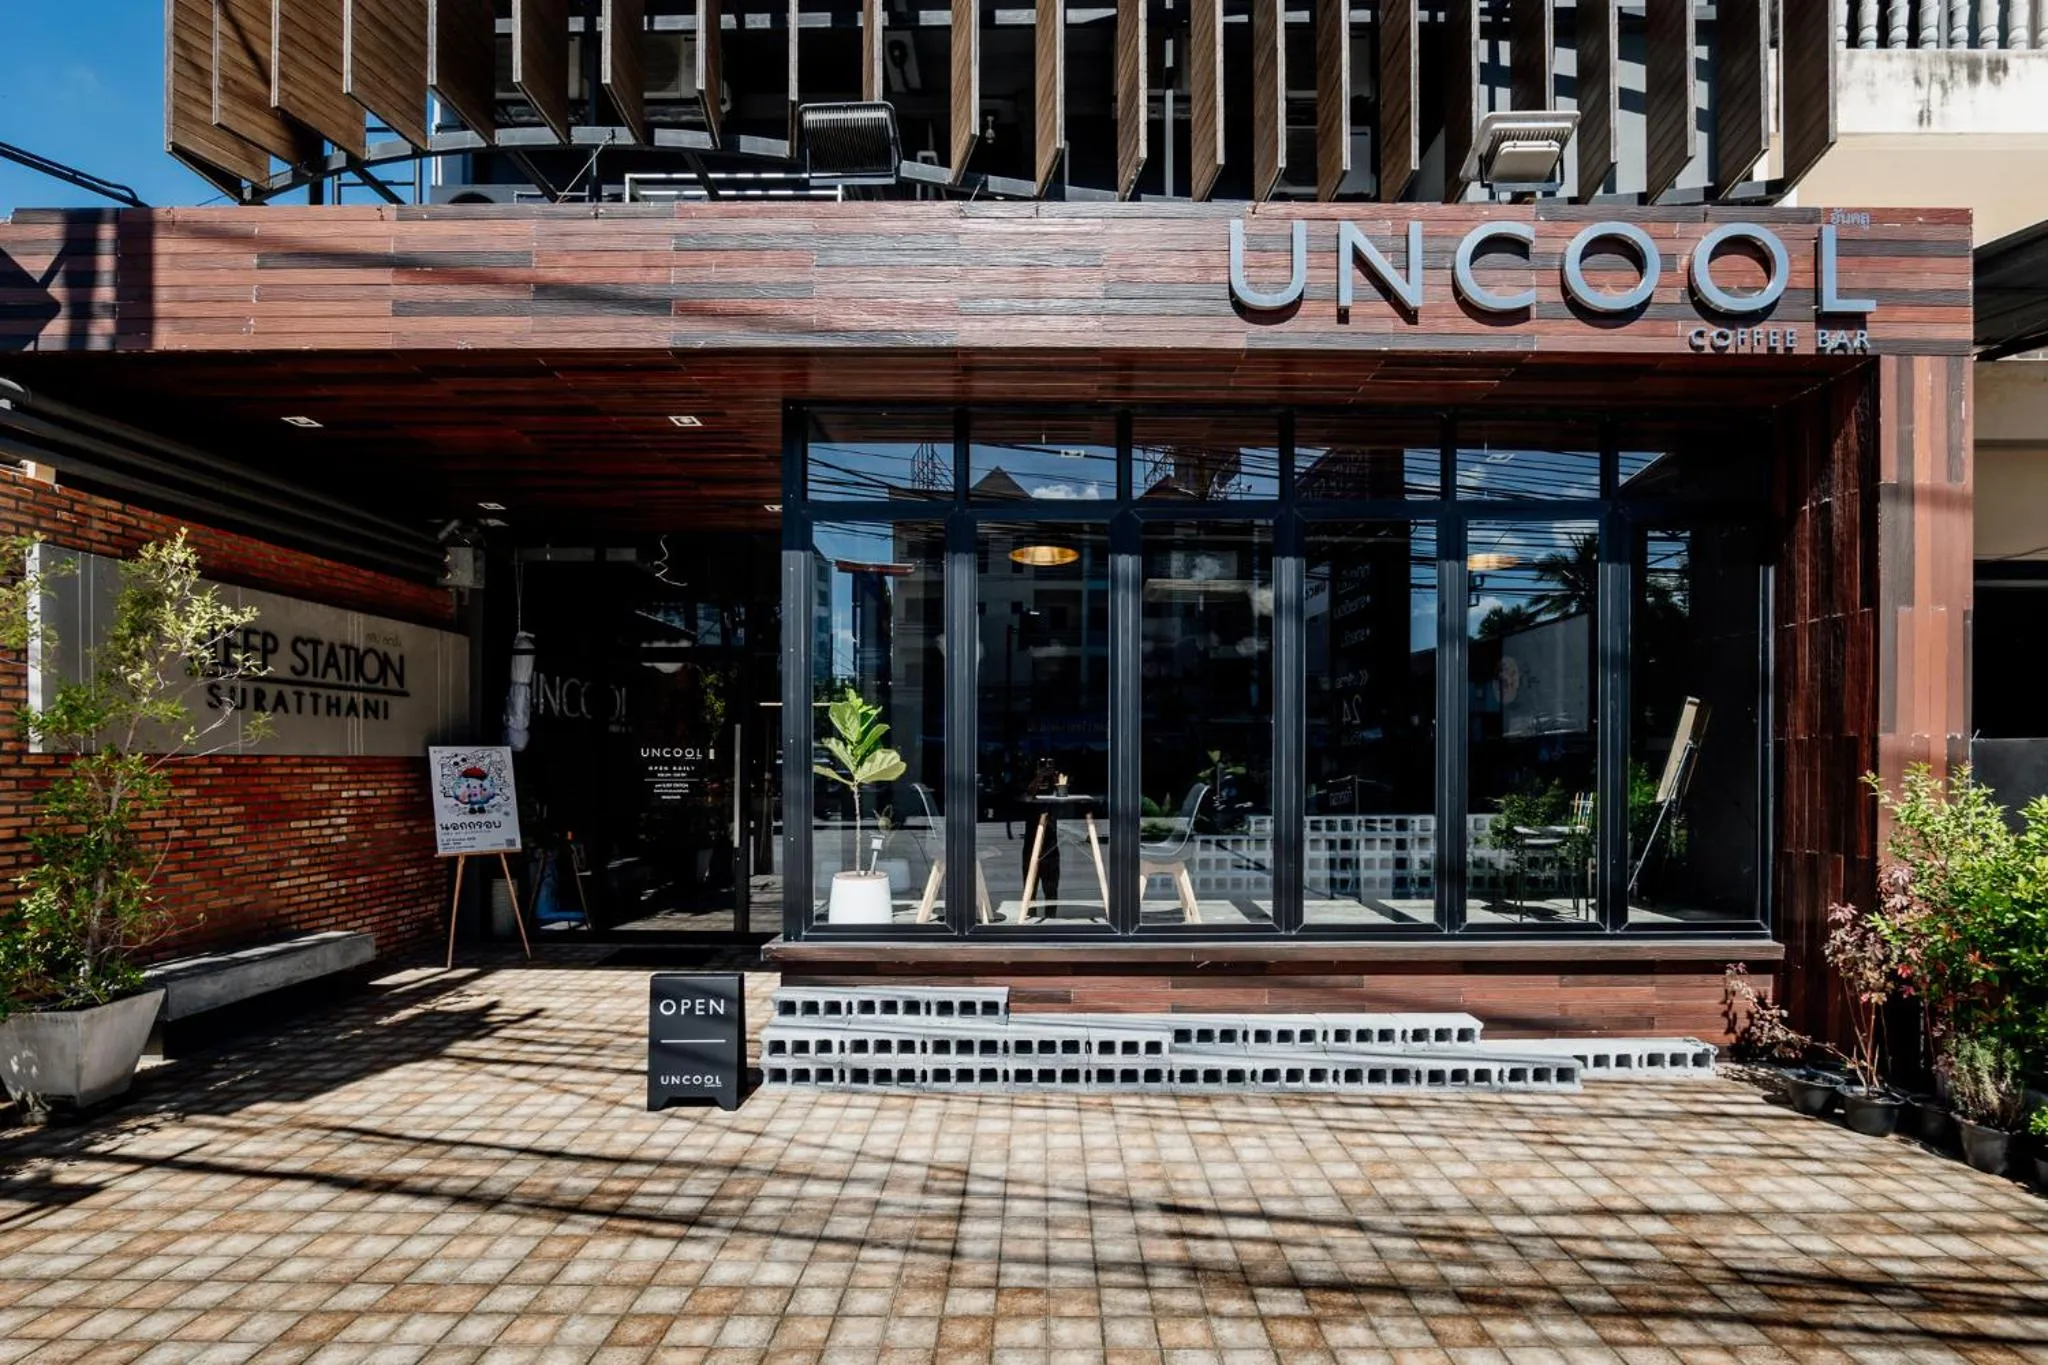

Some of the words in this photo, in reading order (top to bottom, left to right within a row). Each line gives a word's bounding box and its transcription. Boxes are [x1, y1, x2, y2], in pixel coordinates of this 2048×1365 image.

[1228, 219, 1877, 315] UNCOOL
[1689, 327, 1798, 350] COFFEE
[1817, 328, 1871, 350] BAR
[290, 635, 405, 689] STATION
[206, 682, 390, 720] SURATTHANI
[640, 747, 703, 758] UNCOOL
[659, 999, 725, 1016] OPEN
[660, 1074, 722, 1085] UNCOOL
